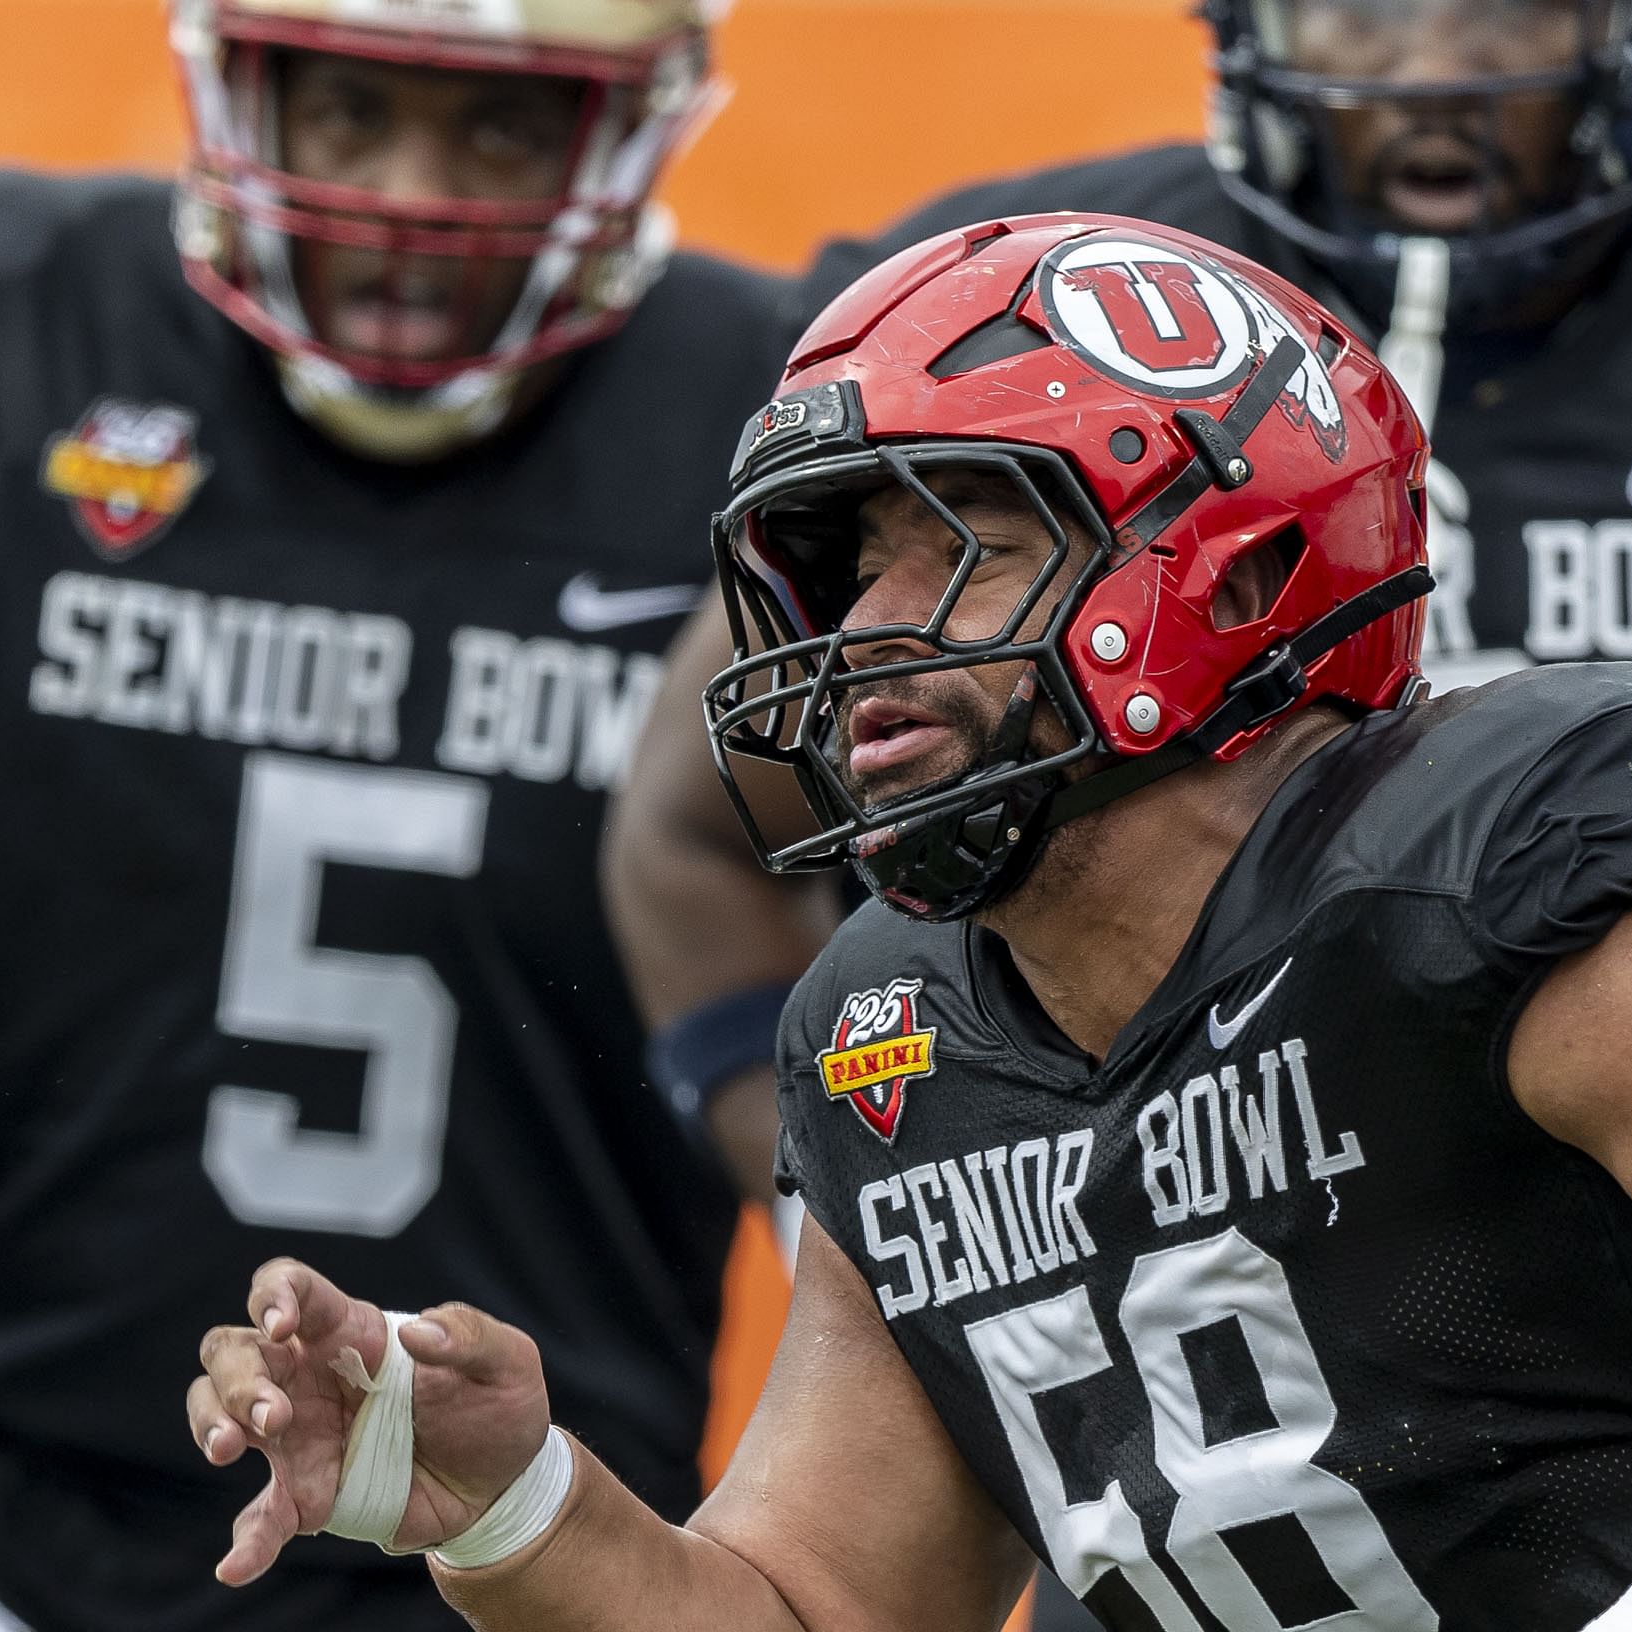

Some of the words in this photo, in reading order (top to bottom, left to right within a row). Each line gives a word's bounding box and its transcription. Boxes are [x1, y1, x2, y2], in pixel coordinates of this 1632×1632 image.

[1062, 261, 1226, 371] U
[30, 572, 413, 761] SENIOR
[202, 754, 492, 1239] 5
[829, 1041, 923, 1085] PANINI
[846, 983, 922, 1047] '25
[859, 1128, 1098, 1321] SENIOR
[1136, 1037, 1366, 1228] BOWL
